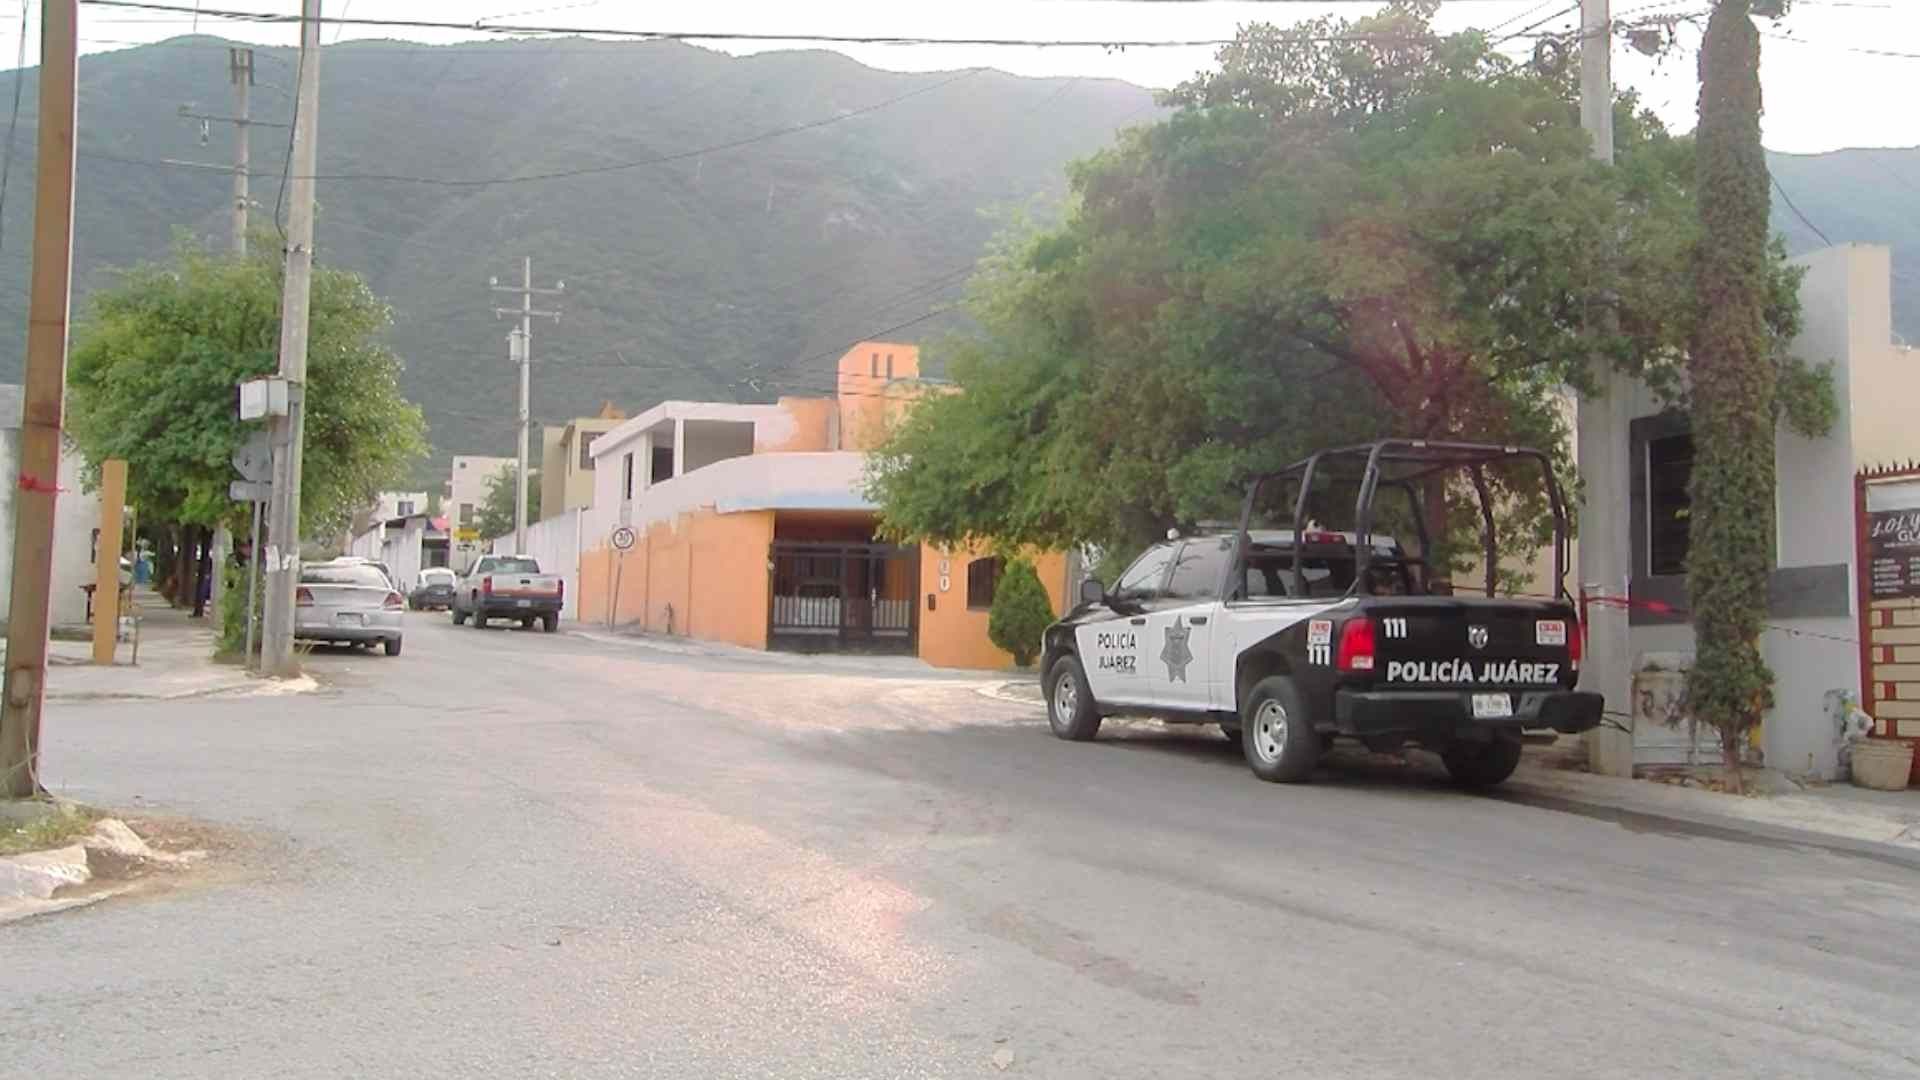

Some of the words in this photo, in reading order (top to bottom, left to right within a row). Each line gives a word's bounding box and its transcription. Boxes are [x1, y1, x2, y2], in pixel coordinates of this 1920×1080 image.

[1383, 617, 1407, 639] 111
[1306, 644, 1330, 665] 111
[1387, 657, 1474, 682] POLICÍA
[1478, 659, 1560, 683] JUÁREZ
